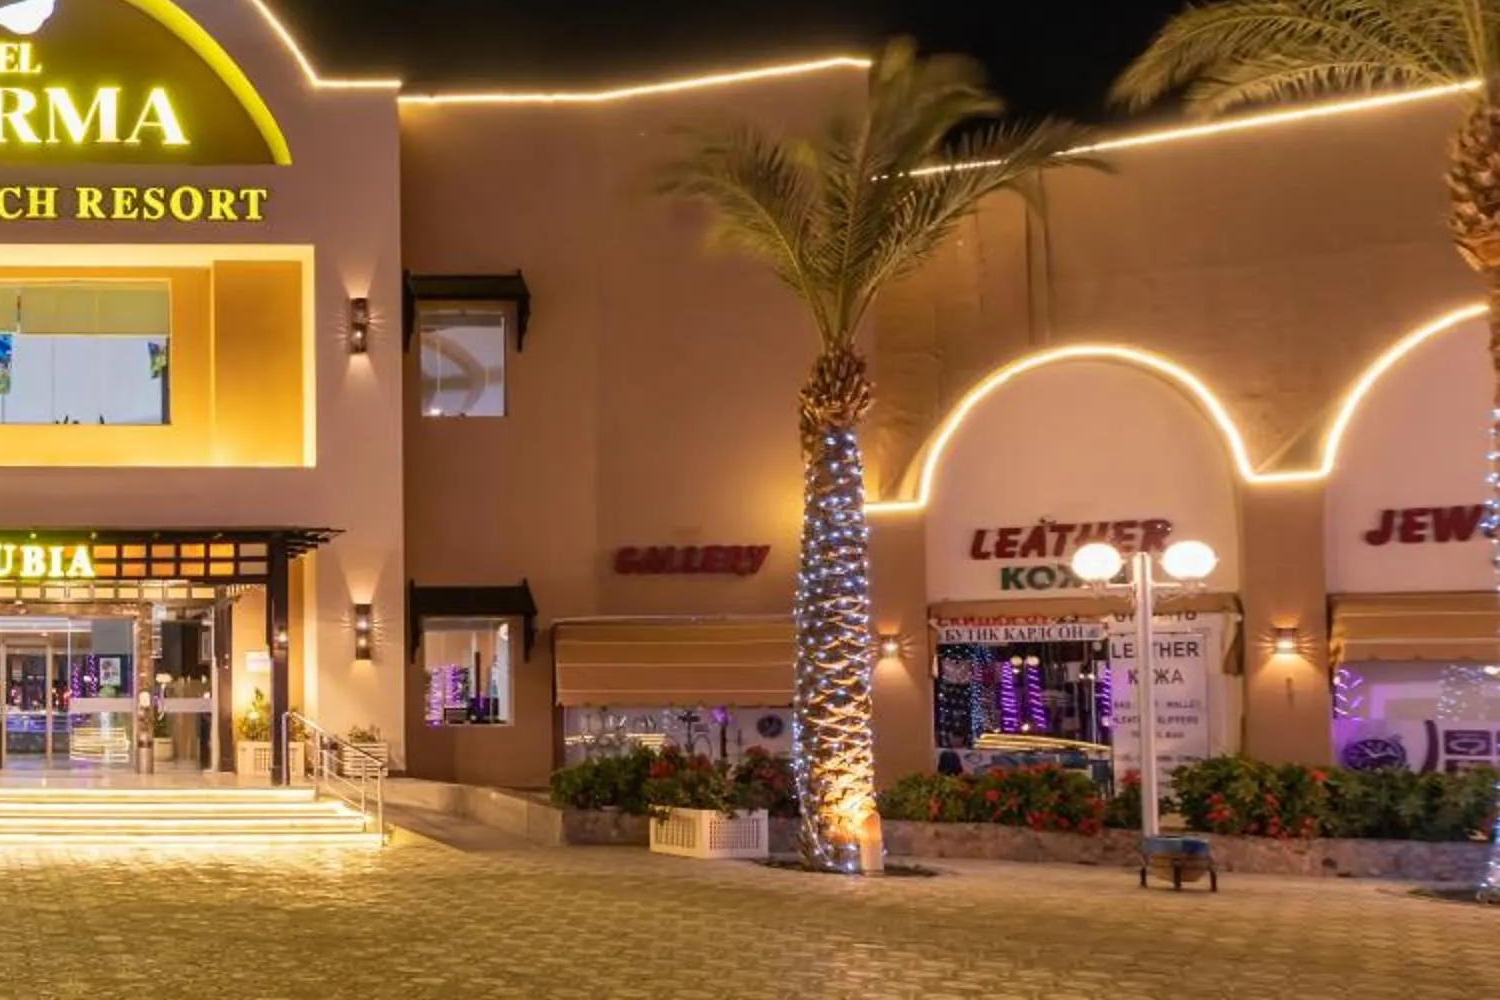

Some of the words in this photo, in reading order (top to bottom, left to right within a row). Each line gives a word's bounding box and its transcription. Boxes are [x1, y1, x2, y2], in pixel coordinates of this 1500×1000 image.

[74, 187, 268, 222] RESORT
[1111, 641, 1200, 658] LETHER
[1127, 667, 1184, 685] КЖА
